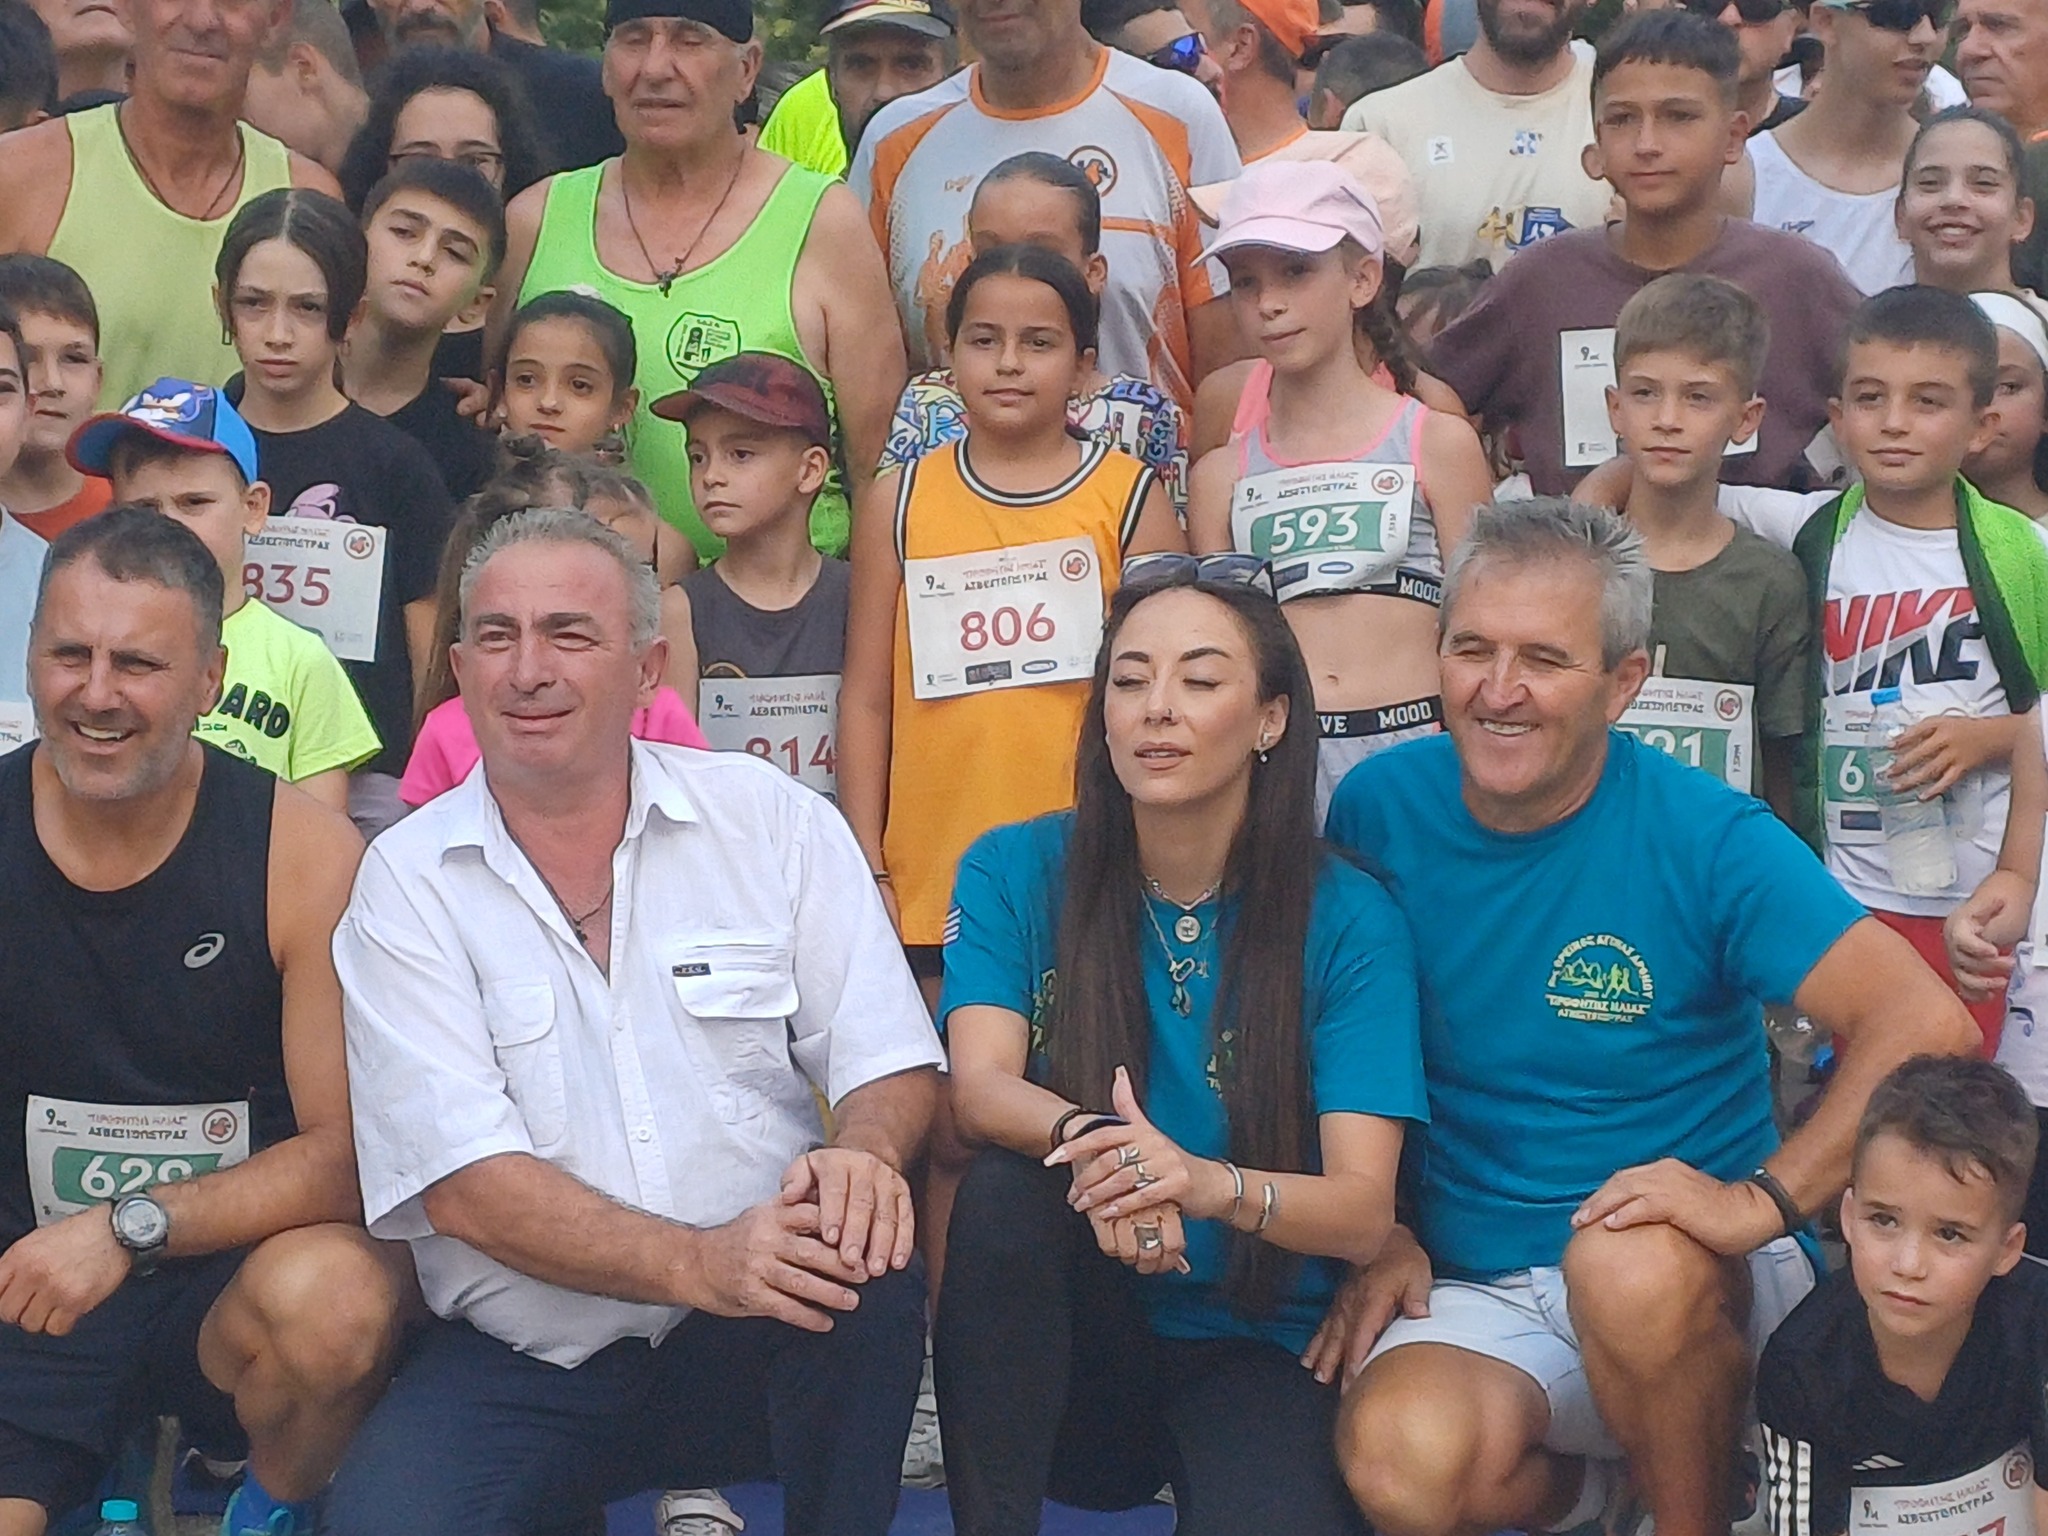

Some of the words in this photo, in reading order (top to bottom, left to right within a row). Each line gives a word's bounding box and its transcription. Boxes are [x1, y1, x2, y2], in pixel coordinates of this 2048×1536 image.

[1270, 504, 1361, 554] 593
[242, 563, 331, 607] 835
[960, 602, 1056, 651] 806
[1823, 587, 1986, 698] NIKE
[1377, 701, 1433, 729] MOOD
